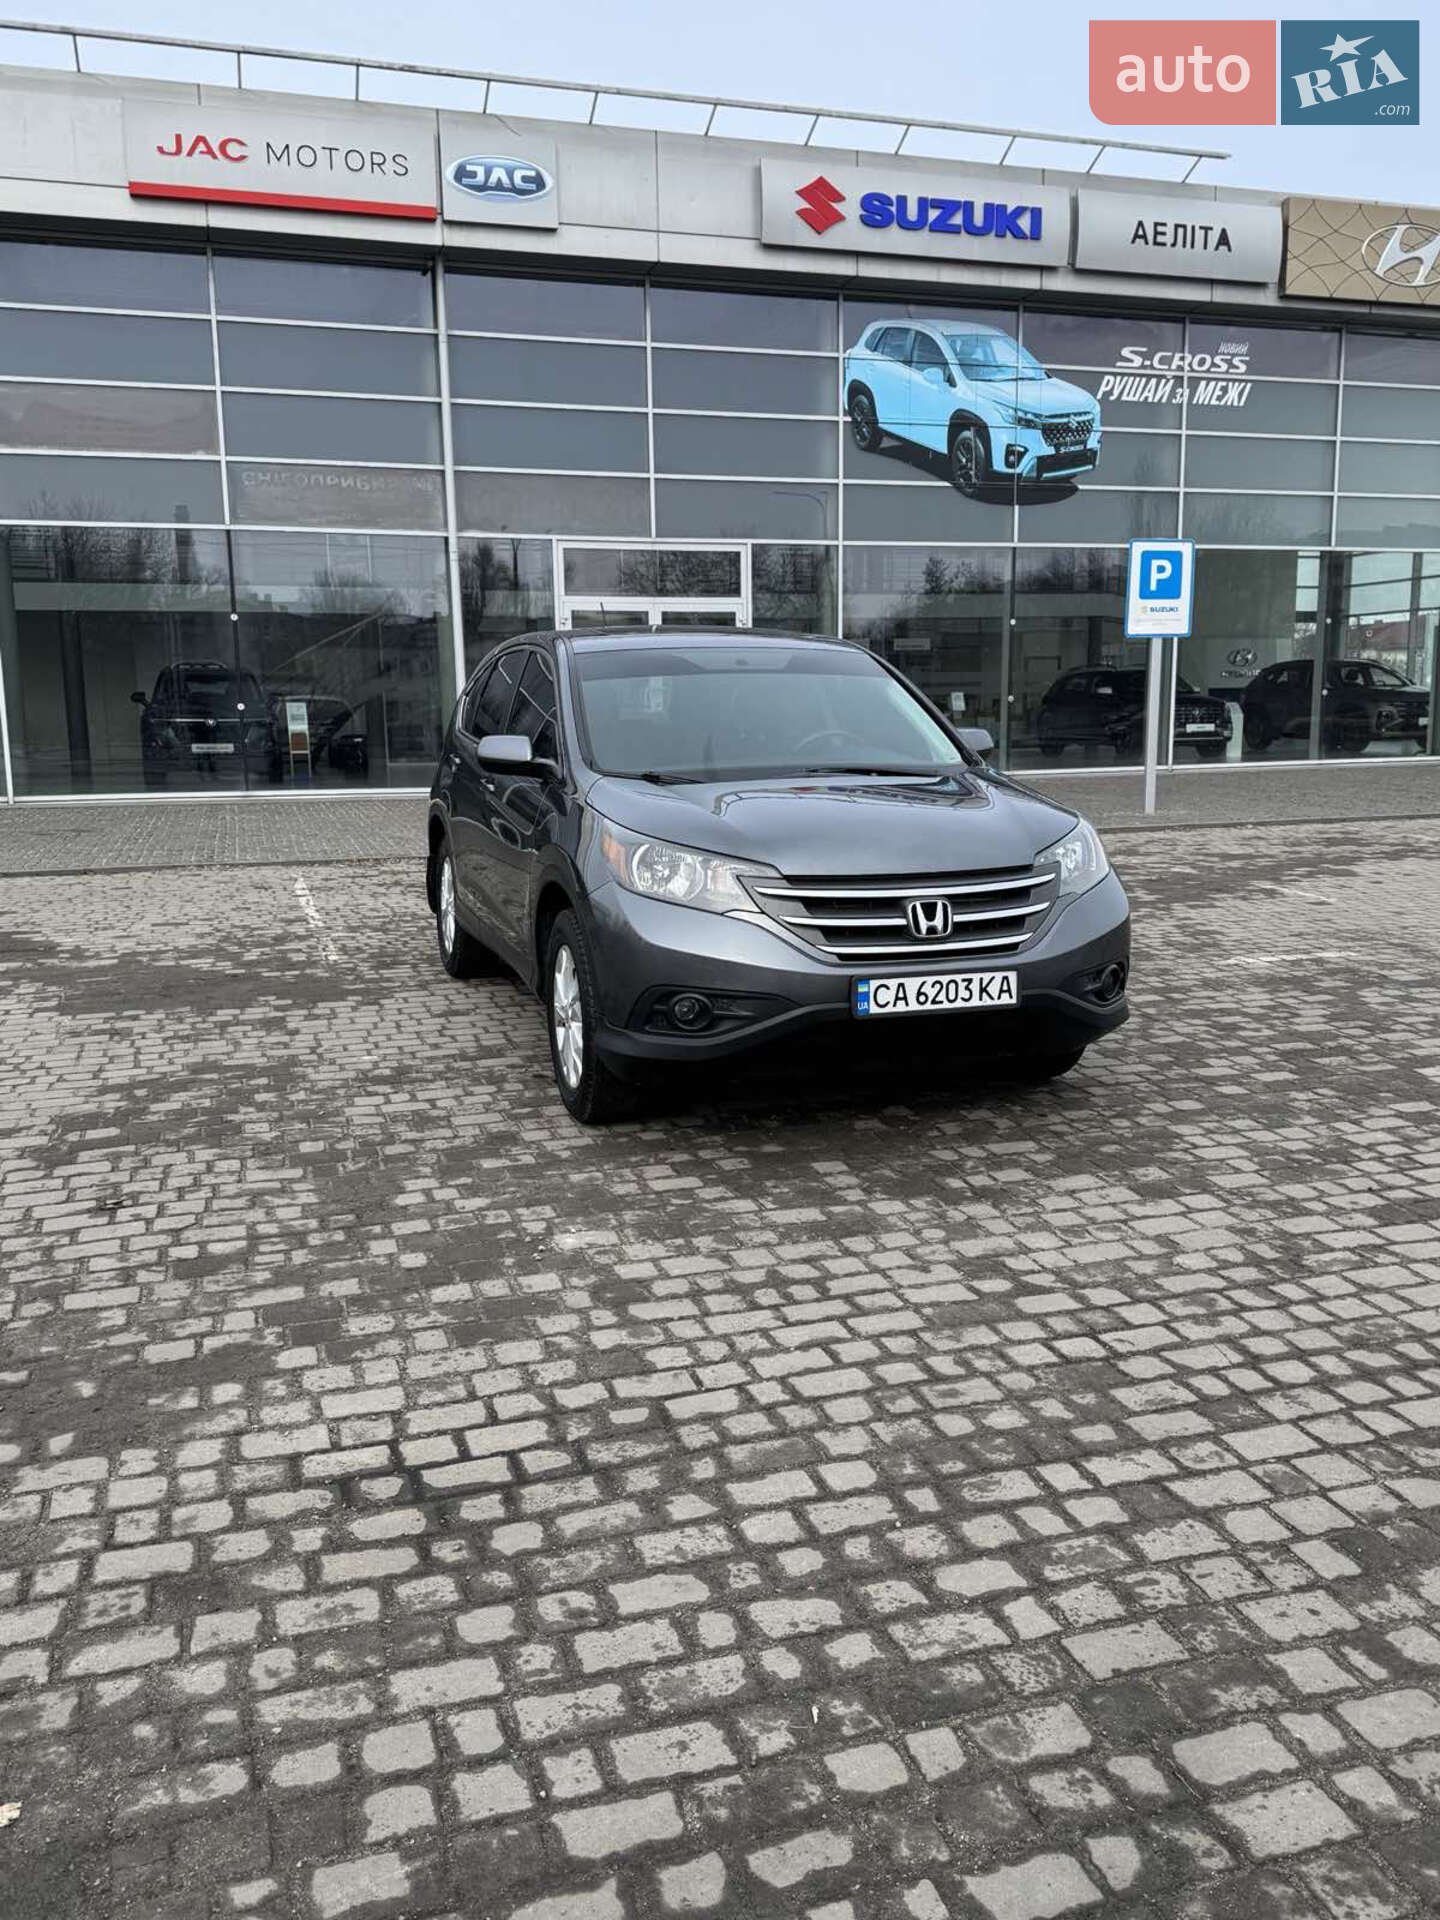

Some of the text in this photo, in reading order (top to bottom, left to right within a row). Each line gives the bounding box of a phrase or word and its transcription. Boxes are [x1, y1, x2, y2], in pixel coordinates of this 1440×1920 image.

[156, 133, 410, 177] JAC MOTORS
[461, 163, 538, 191] JAC
[859, 191, 1043, 241] SUZUKI
[1130, 219, 1233, 253] АЕЛІТА
[1097, 374, 1174, 403] РУШАЙ
[1192, 380, 1252, 407] МЕЖІ
[1149, 558, 1173, 593] P
[873, 975, 1013, 1008] CA 6203 KA
